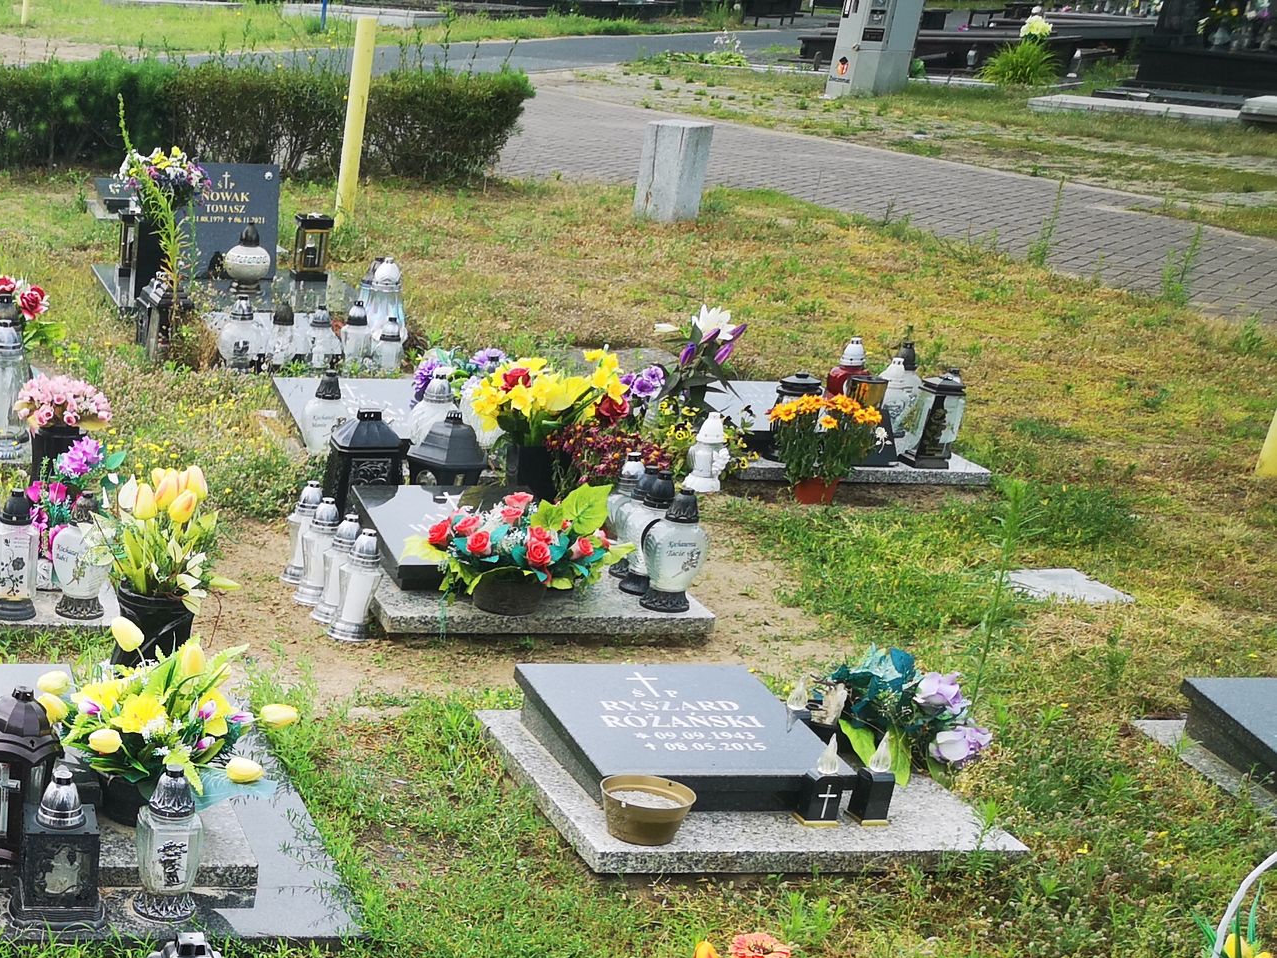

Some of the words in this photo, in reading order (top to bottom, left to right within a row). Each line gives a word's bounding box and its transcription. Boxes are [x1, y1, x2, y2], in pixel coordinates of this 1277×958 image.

[202, 191, 250, 202] NOWAK
[205, 204, 246, 214] TOMASZ
[600, 700, 740, 712] RYSZARD
[600, 711, 765, 728] RÓŻAŃSKI
[654, 731, 756, 740] 09.09.1943
[664, 742, 767, 751] 08.05.2015
